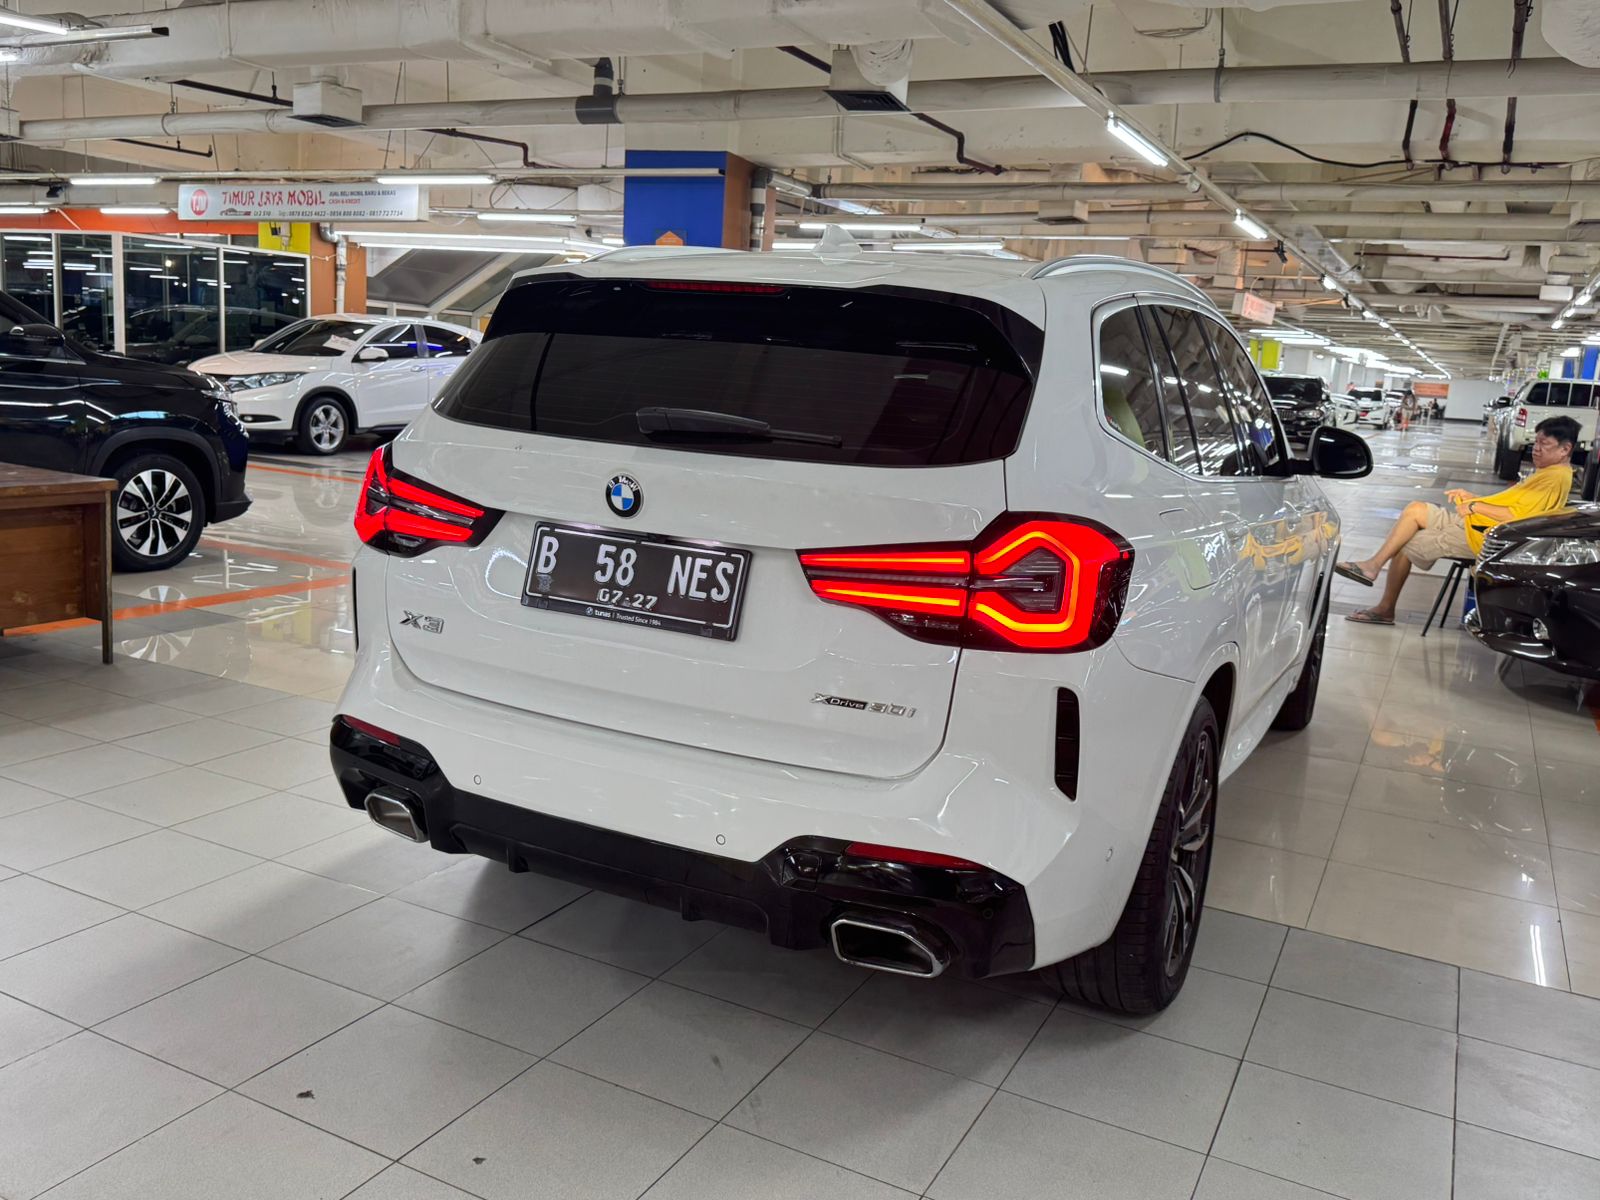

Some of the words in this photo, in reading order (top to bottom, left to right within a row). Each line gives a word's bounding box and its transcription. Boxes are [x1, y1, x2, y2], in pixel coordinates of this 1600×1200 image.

[222, 191, 255, 206] TIMUR
[258, 191, 284, 207] JAYA
[287, 190, 325, 206] MOBIL
[608, 476, 639, 492] BMW
[536, 536, 560, 574] B
[593, 544, 638, 587] 58
[667, 554, 736, 602] NES
[399, 610, 444, 634] X3
[594, 609, 611, 618] tunas
[616, 613, 635, 622] Trusted
[635, 616, 648, 625] Since
